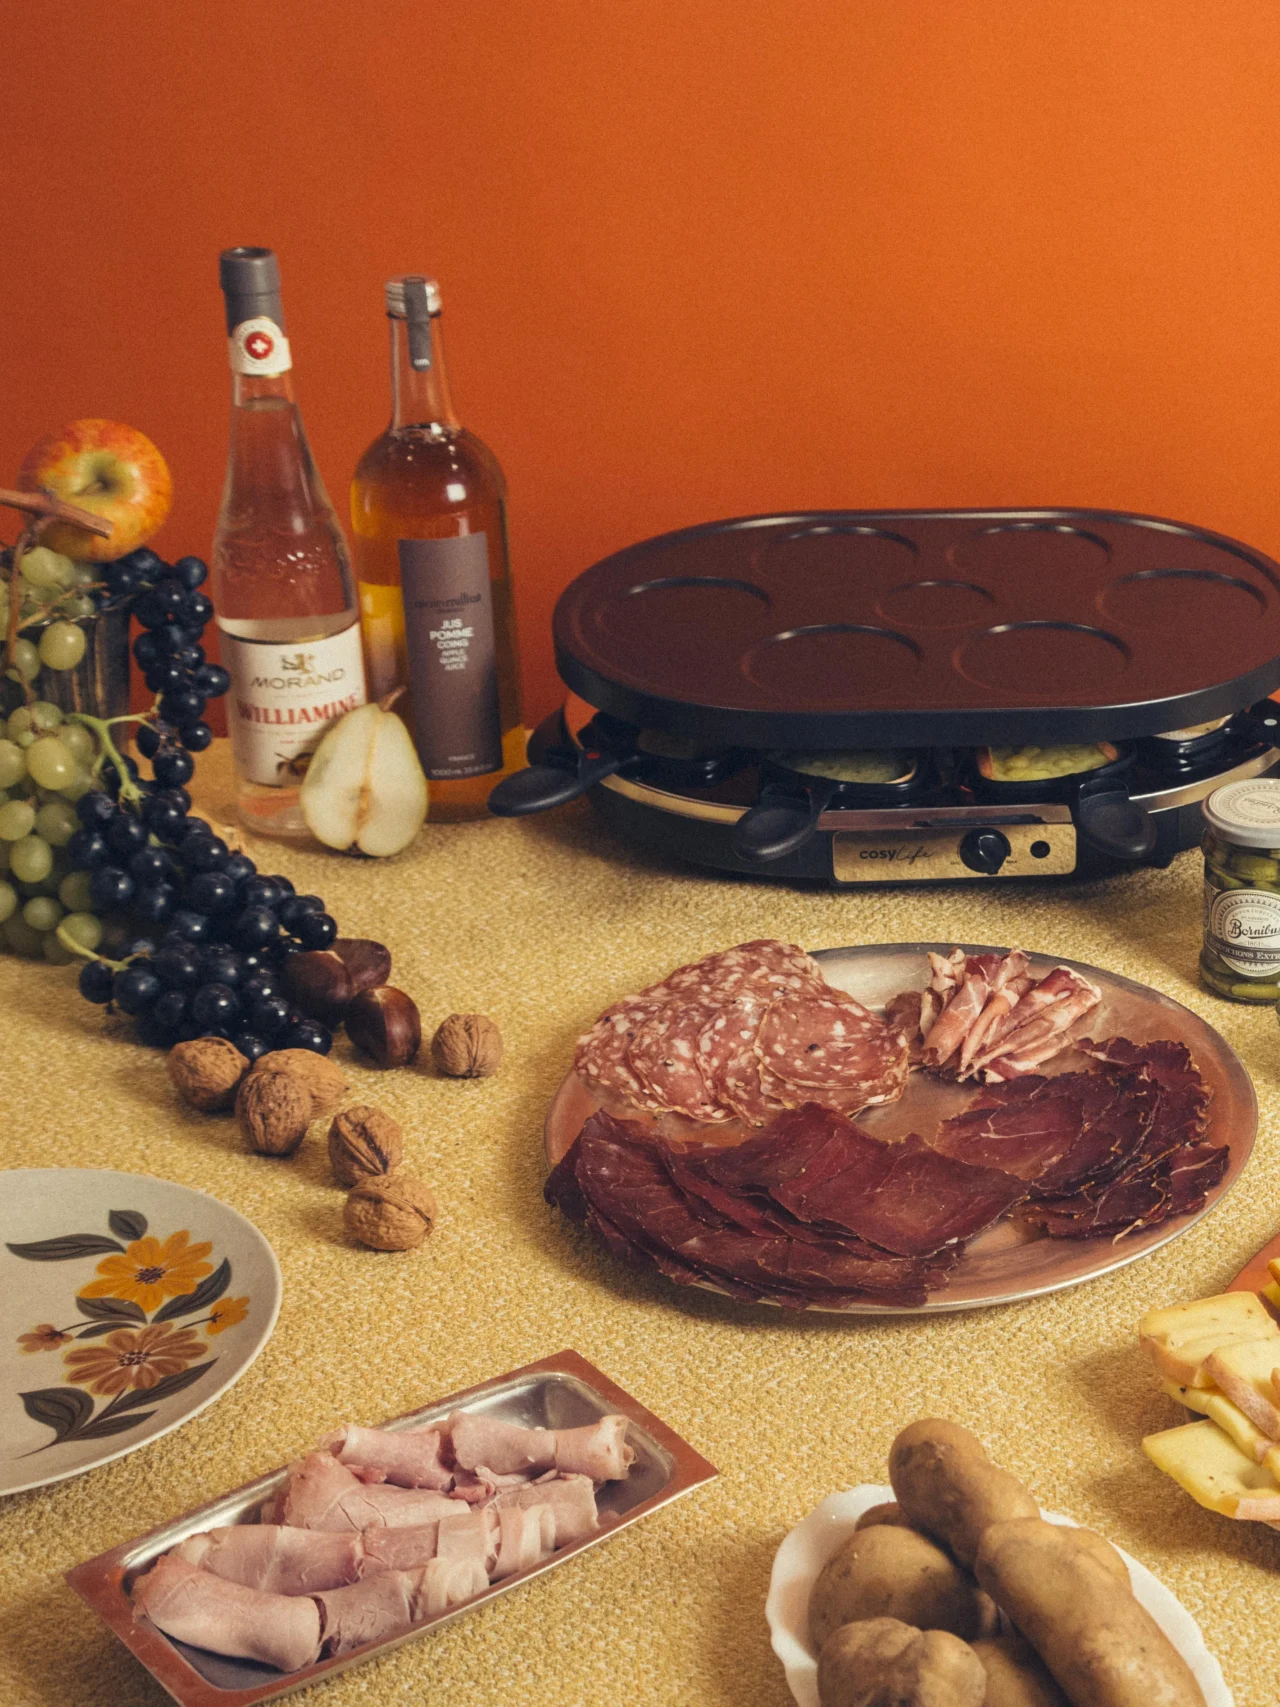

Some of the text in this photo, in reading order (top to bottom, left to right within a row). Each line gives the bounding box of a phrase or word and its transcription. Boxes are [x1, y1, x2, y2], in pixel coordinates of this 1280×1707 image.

[441, 619, 462, 629] JUS
[430, 627, 474, 640] POMME
[251, 668, 345, 690] MORAND
